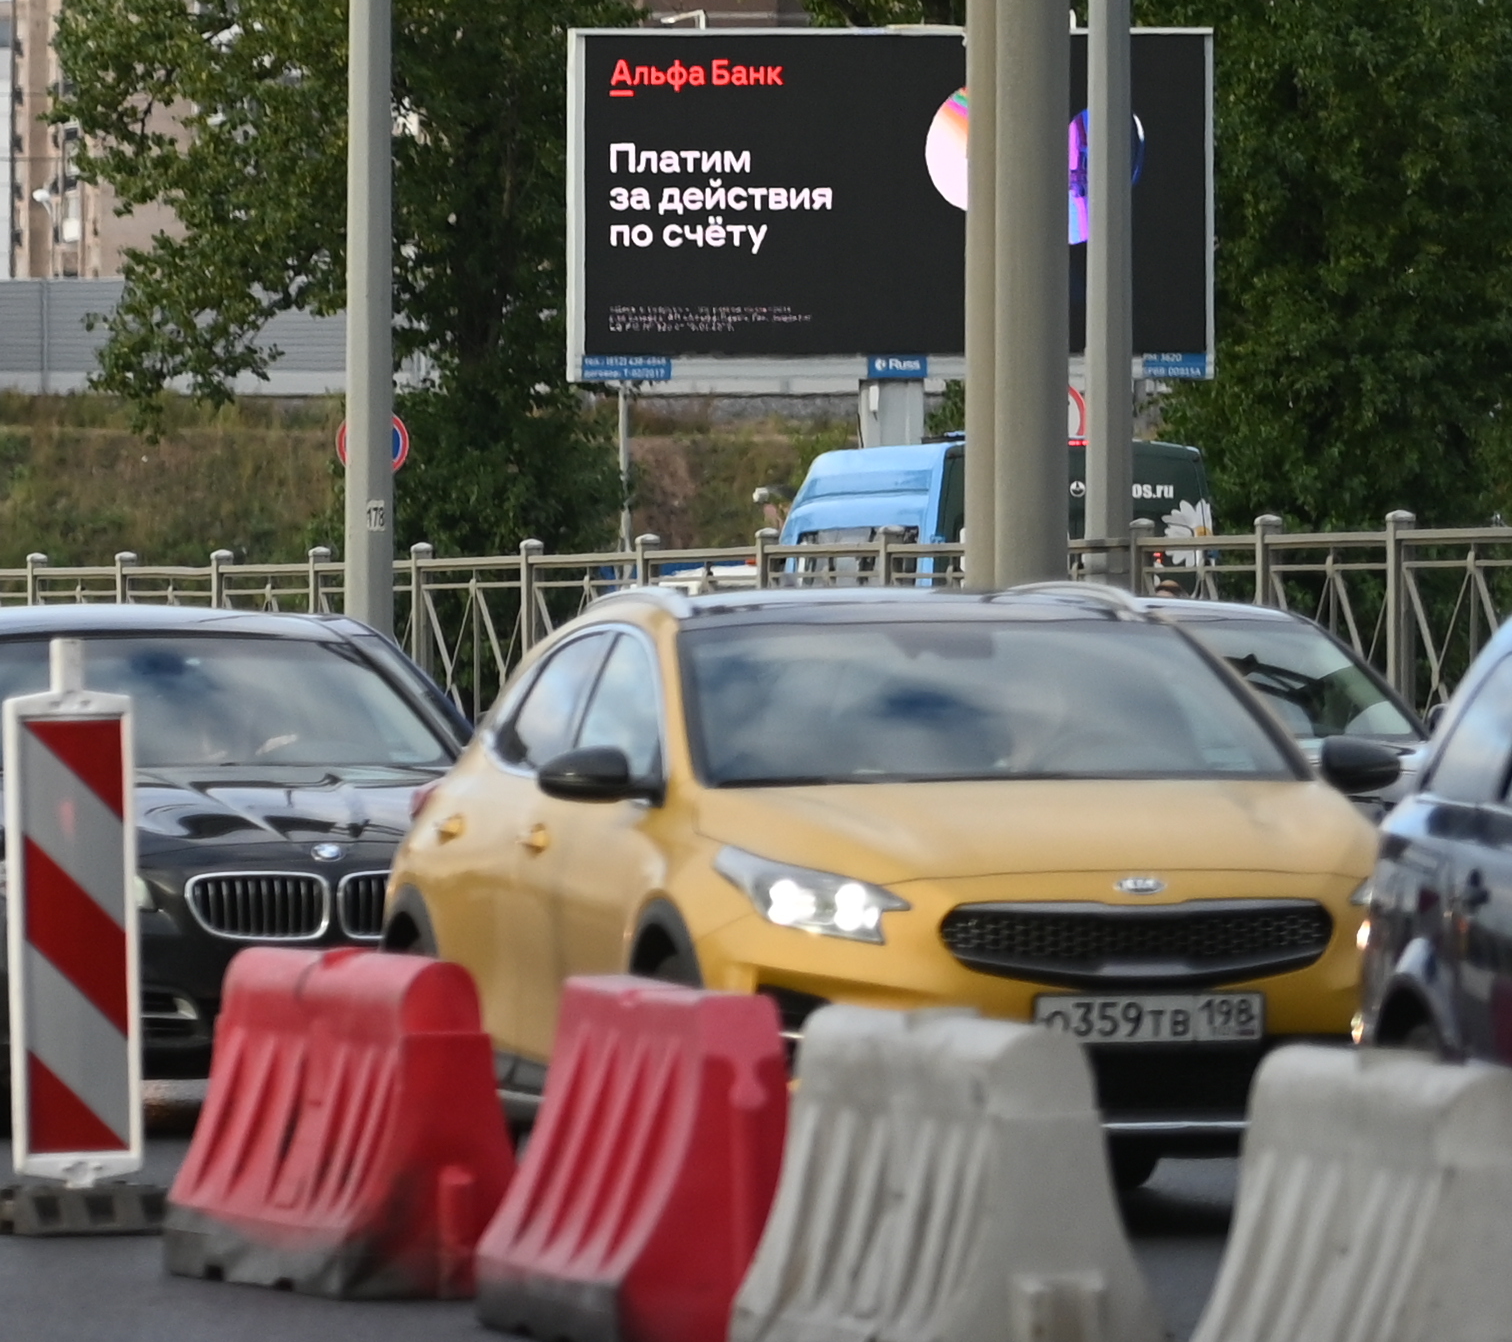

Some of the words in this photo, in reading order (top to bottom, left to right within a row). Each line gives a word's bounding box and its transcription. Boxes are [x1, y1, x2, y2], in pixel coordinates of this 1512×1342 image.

[610, 58, 706, 95] Альфа
[712, 59, 784, 86] Банк
[610, 143, 751, 173] Платим
[610, 186, 651, 211] за
[657, 178, 833, 215] действия
[610, 224, 654, 248] по
[660, 214, 768, 255] счёту
[888, 358, 921, 371] Russ
[1199, 998, 1254, 1026] 198
